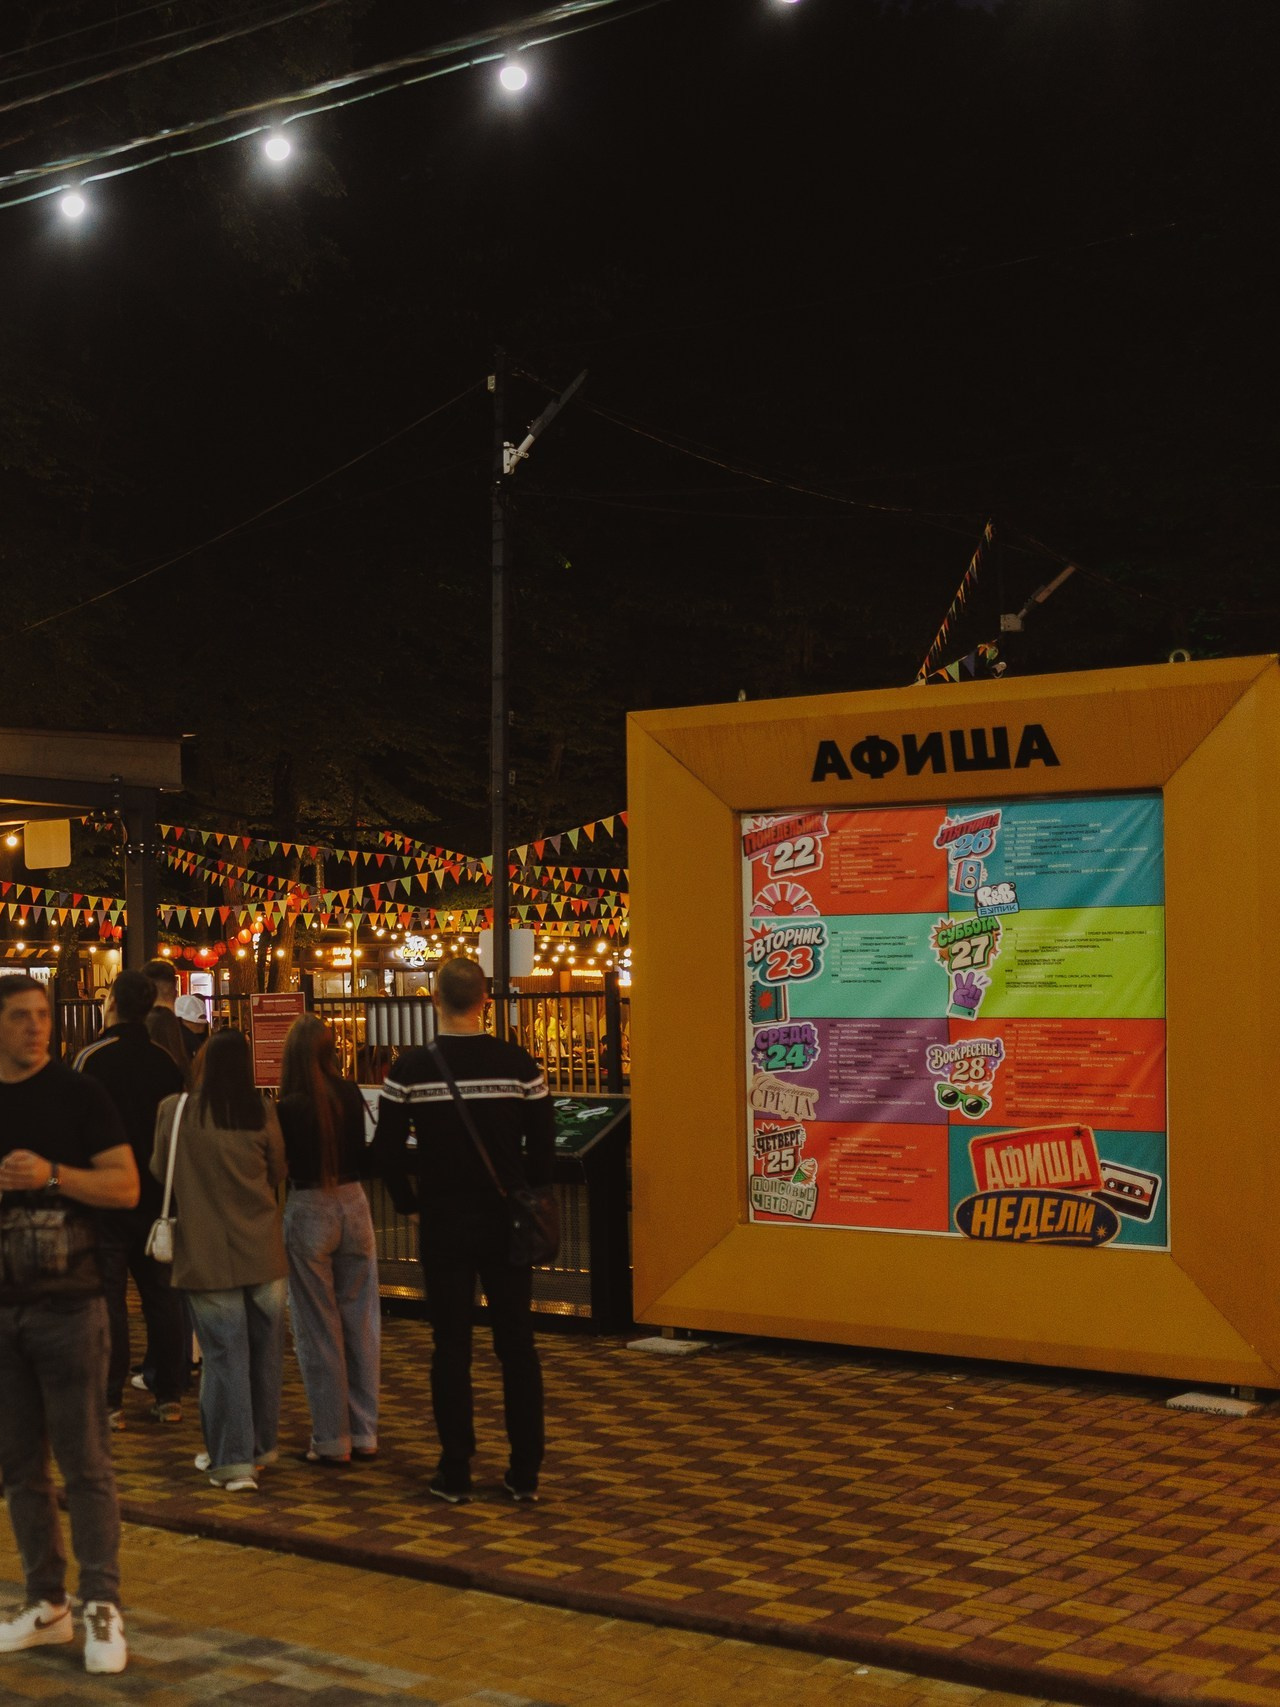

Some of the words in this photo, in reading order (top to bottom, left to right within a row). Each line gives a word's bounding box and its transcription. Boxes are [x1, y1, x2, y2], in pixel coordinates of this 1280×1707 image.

[812, 724, 1060, 782] АФИША
[743, 813, 822, 857] ПОНЕДЕЛЬНИК
[937, 812, 1001, 846] ПЯТНИЦА
[954, 828, 992, 860] 26
[774, 837, 815, 873] 22
[976, 883, 1016, 906] R&B
[753, 926, 823, 963] ВТОРНИК
[937, 916, 1000, 947] СУББОТА
[767, 946, 814, 980] 23
[951, 935, 990, 969] 27
[756, 1024, 815, 1050] СРЕДА
[766, 1044, 807, 1070] 24
[931, 1042, 1000, 1069] ВОСКРЕСЕНЬЕ
[952, 1056, 986, 1082] 28
[756, 1130, 801, 1153] ЧЕТВЕРГ
[767, 1148, 795, 1173] 25
[984, 1139, 1092, 1191] АФИША
[970, 1196, 1096, 1240] НЕДЕЛИ
